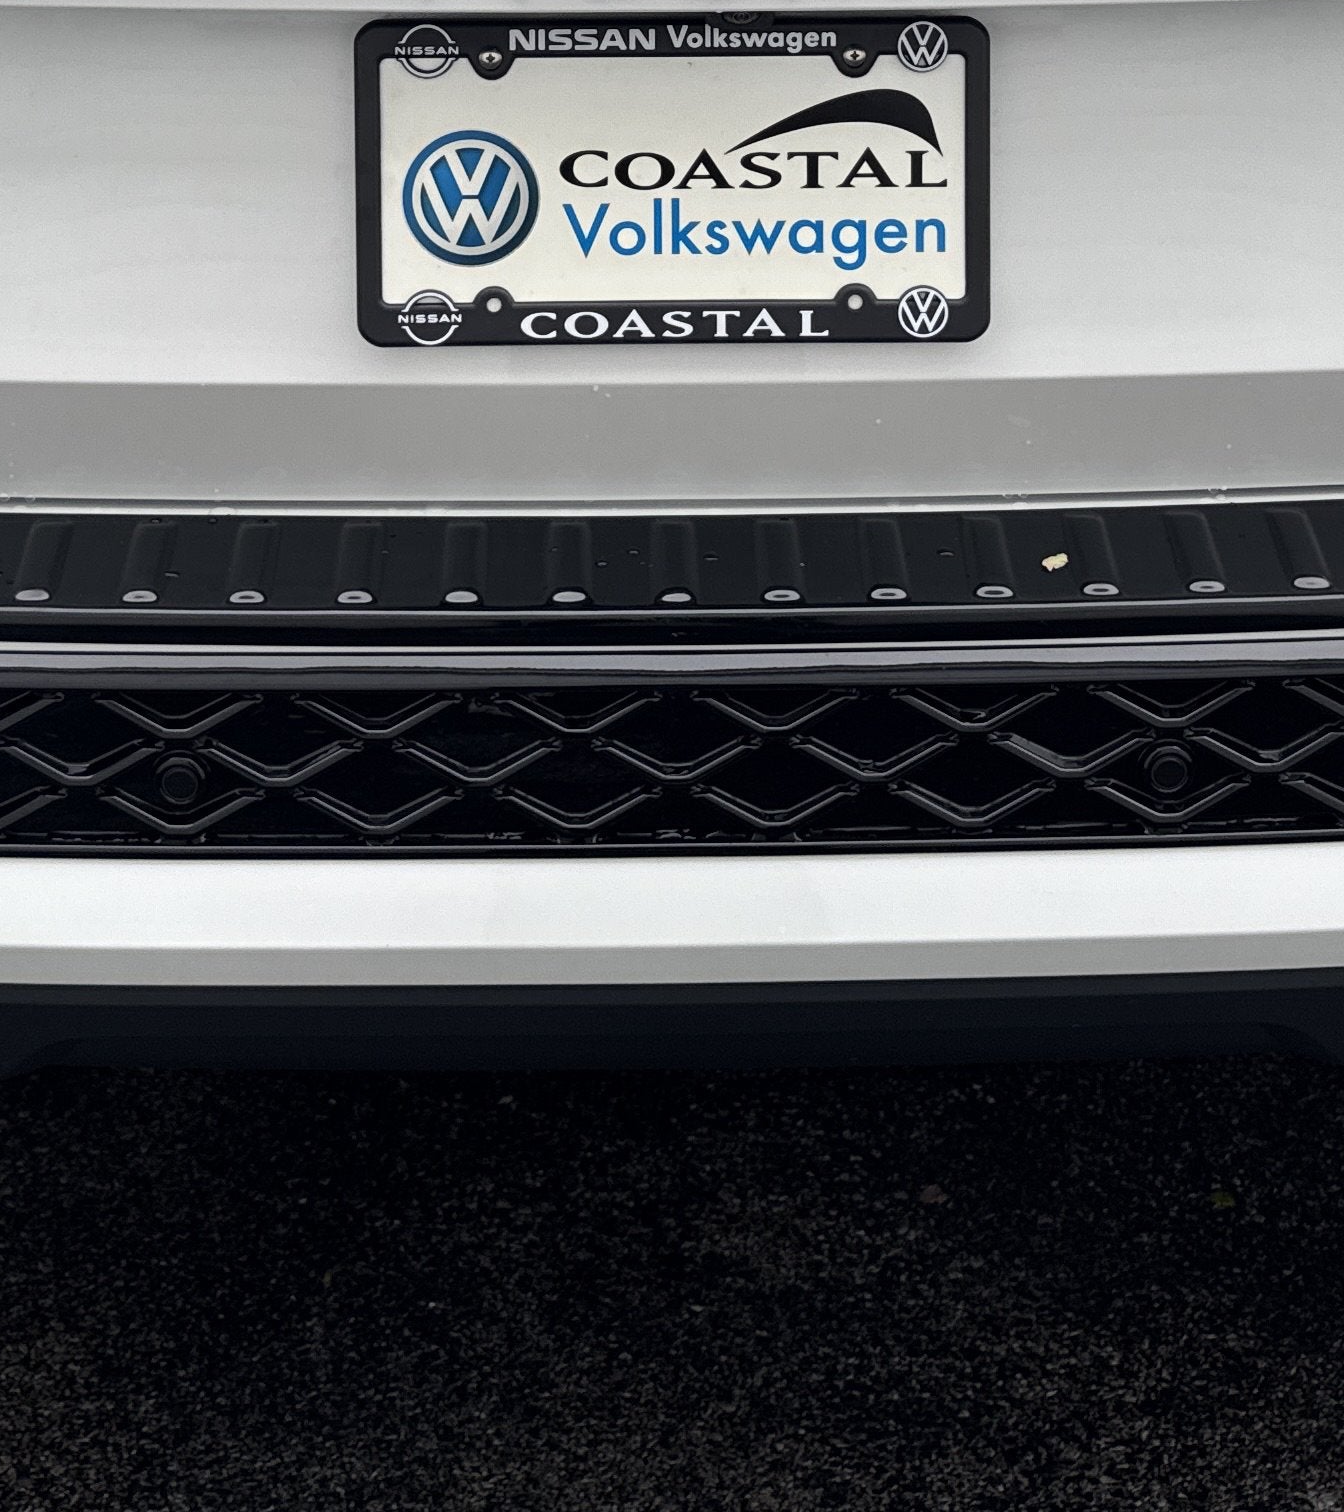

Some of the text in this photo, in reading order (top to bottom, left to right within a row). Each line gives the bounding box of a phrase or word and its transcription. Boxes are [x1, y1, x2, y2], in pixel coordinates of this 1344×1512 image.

[394, 45, 460, 56] NISSAN
[509, 24, 838, 53] NISSAN Volkswagen
[559, 146, 948, 190] COASTAL
[562, 198, 947, 271] Volkswagen
[397, 313, 463, 325] NISSAN
[520, 310, 830, 339] COASTAL
